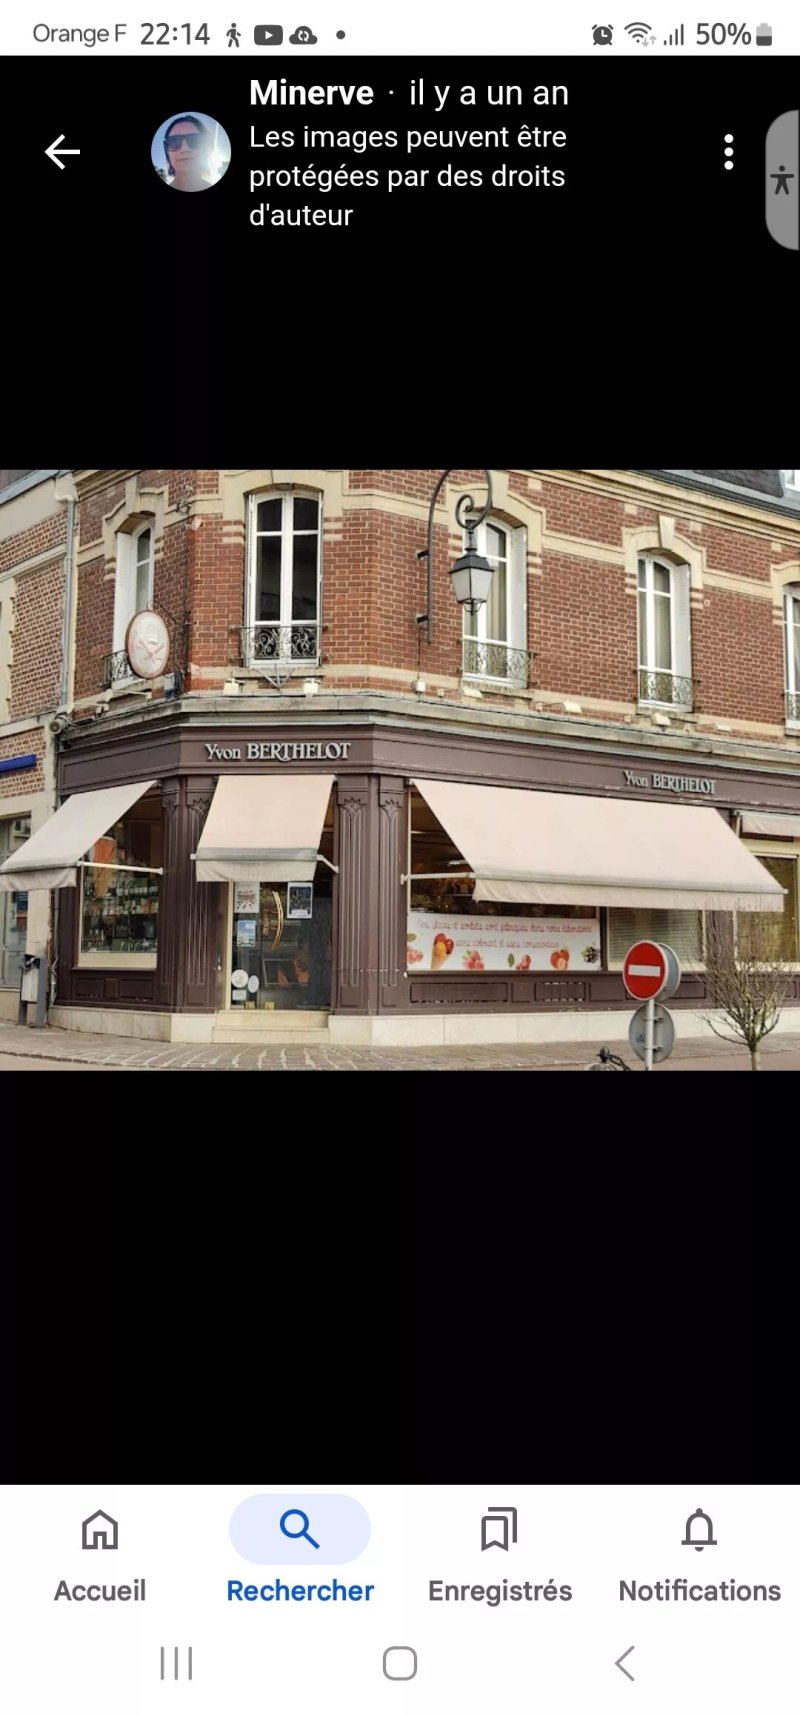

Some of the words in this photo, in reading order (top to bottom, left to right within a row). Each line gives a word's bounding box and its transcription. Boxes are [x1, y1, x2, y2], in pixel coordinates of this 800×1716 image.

[205, 743, 241, 760] Yvon
[247, 742, 351, 762] BERTHELOT
[624, 770, 648, 787] Yvon
[653, 773, 716, 794] BERTHELOT
